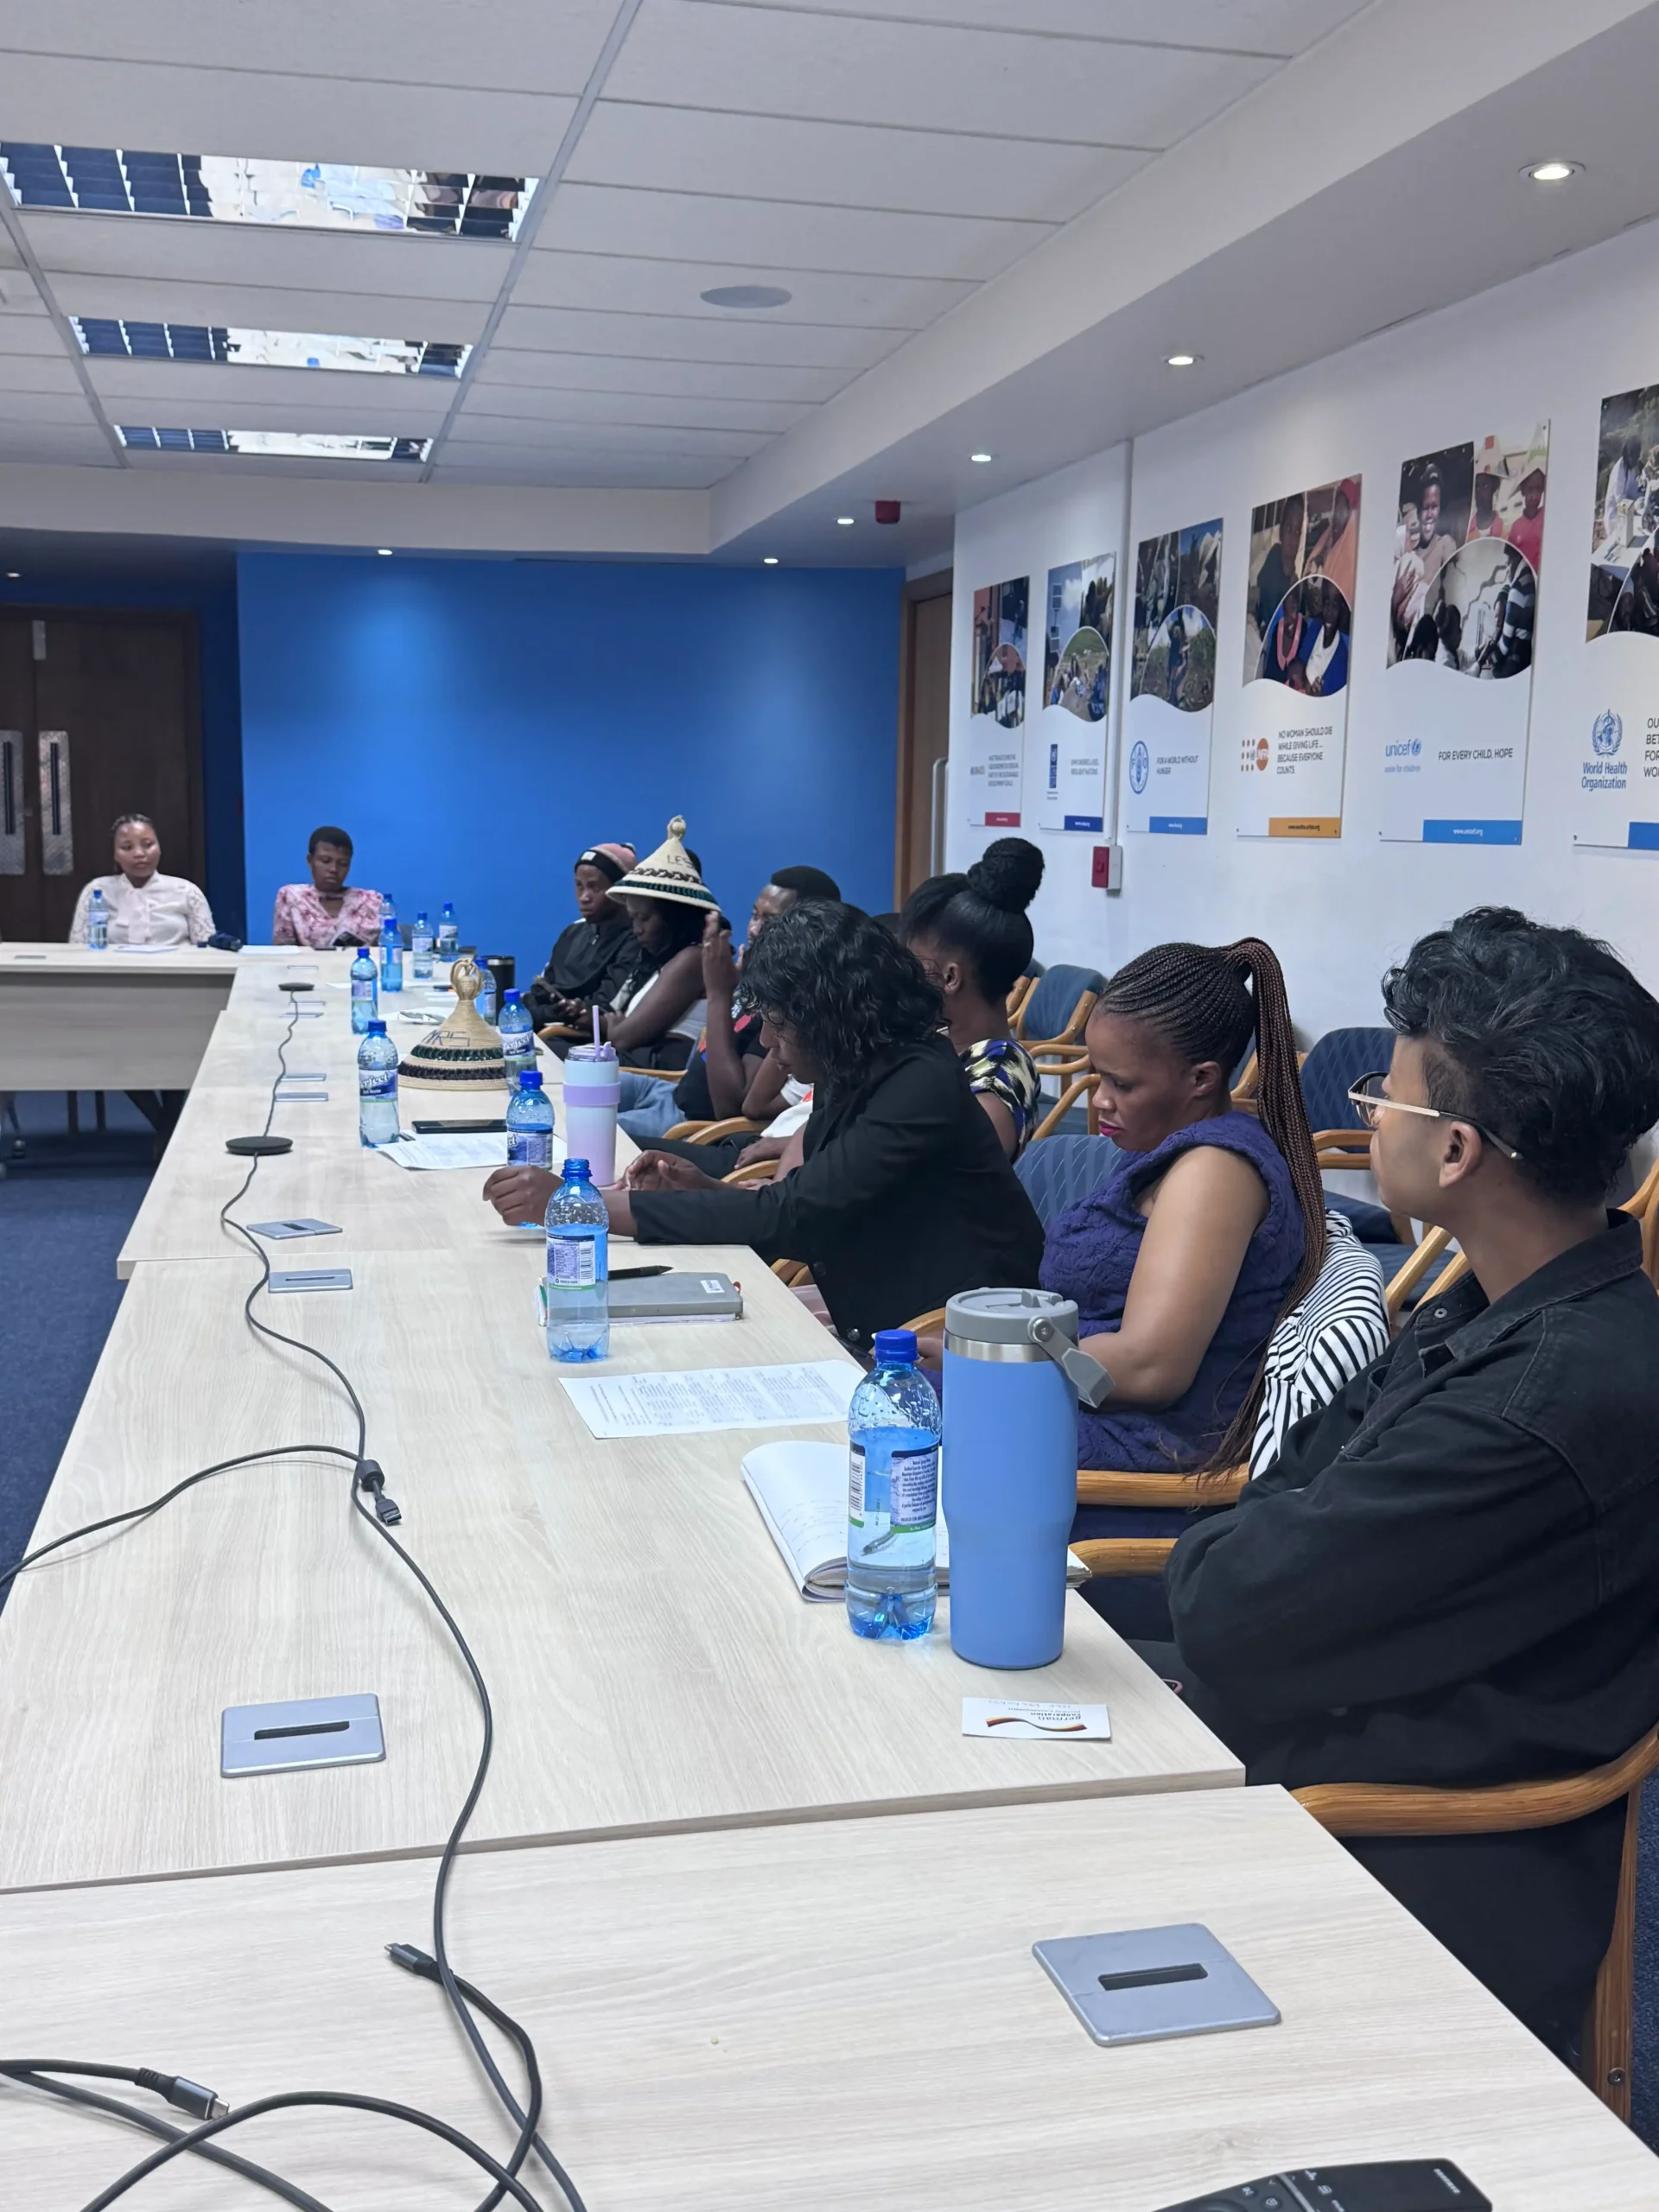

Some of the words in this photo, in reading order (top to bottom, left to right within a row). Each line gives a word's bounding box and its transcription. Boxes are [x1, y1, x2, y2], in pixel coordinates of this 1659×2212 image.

[1279, 730, 1286, 739] NO
[1287, 728, 1304, 738] WOMAN
[1305, 727, 1324, 736] SHOULD
[1278, 741, 1292, 750] WHILE
[1293, 741, 1308, 750] GIVING
[1309, 740, 1319, 749] LIFE
[1385, 739, 1411, 757] unicef
[1277, 753, 1298, 763] BECAUSE
[1299, 752, 1323, 762] EVERYONE
[1439, 751, 1451, 760] FOR
[1452, 750, 1471, 760] EVERY
[1494, 747, 1513, 759] HOPE
[1583, 760, 1603, 774] World
[1605, 761, 1627, 774] Health
[1643, 766, 1659, 778] WO
[1581, 776, 1626, 791] Organization
